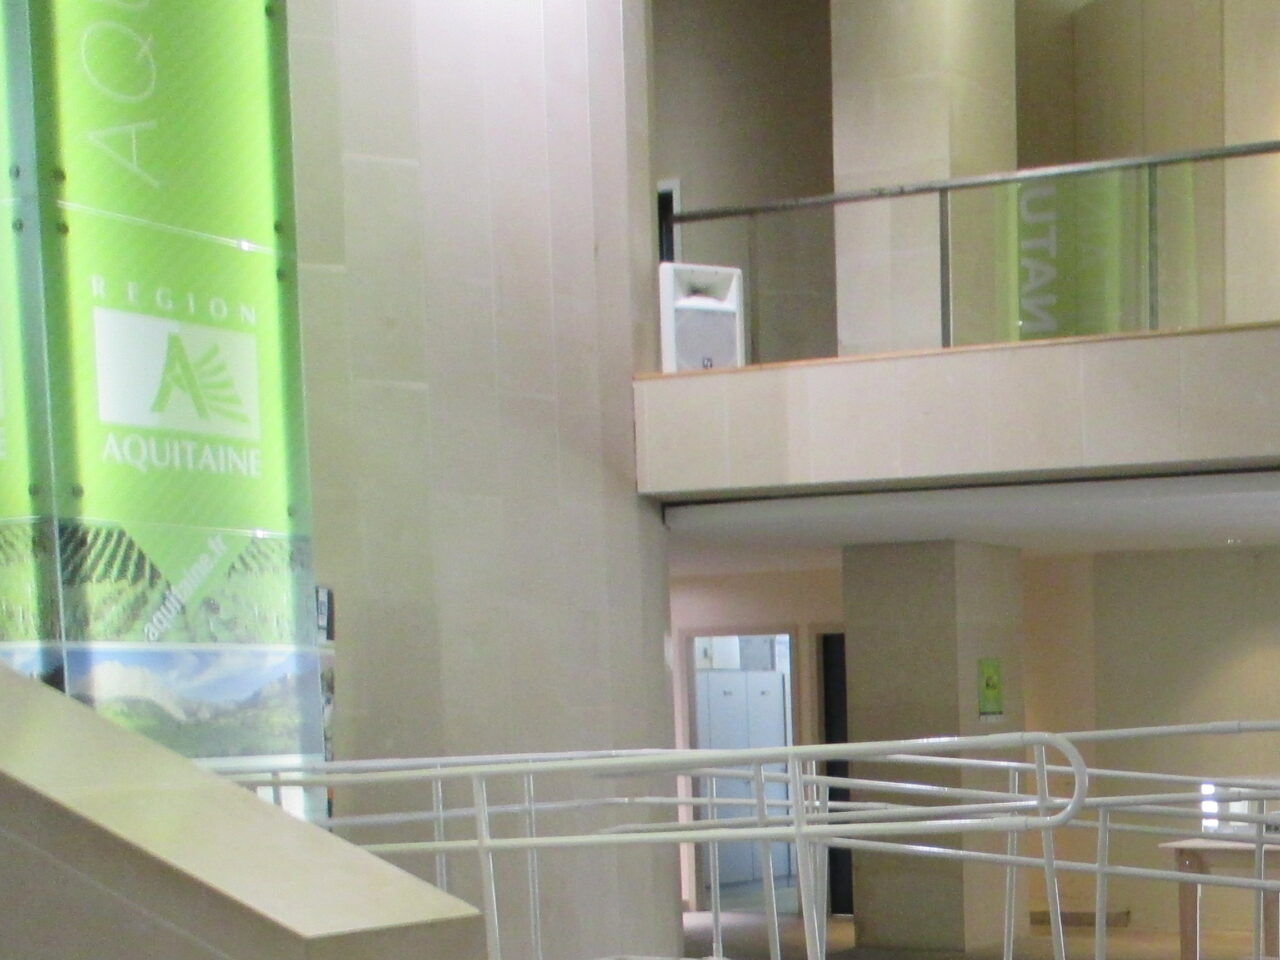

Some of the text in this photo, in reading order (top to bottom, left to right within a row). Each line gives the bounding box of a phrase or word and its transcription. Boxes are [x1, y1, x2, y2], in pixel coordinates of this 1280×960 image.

[80, 0, 160, 188] AQ
[91, 274, 257, 325] REGION
[102, 431, 262, 476] AQUITAINE
